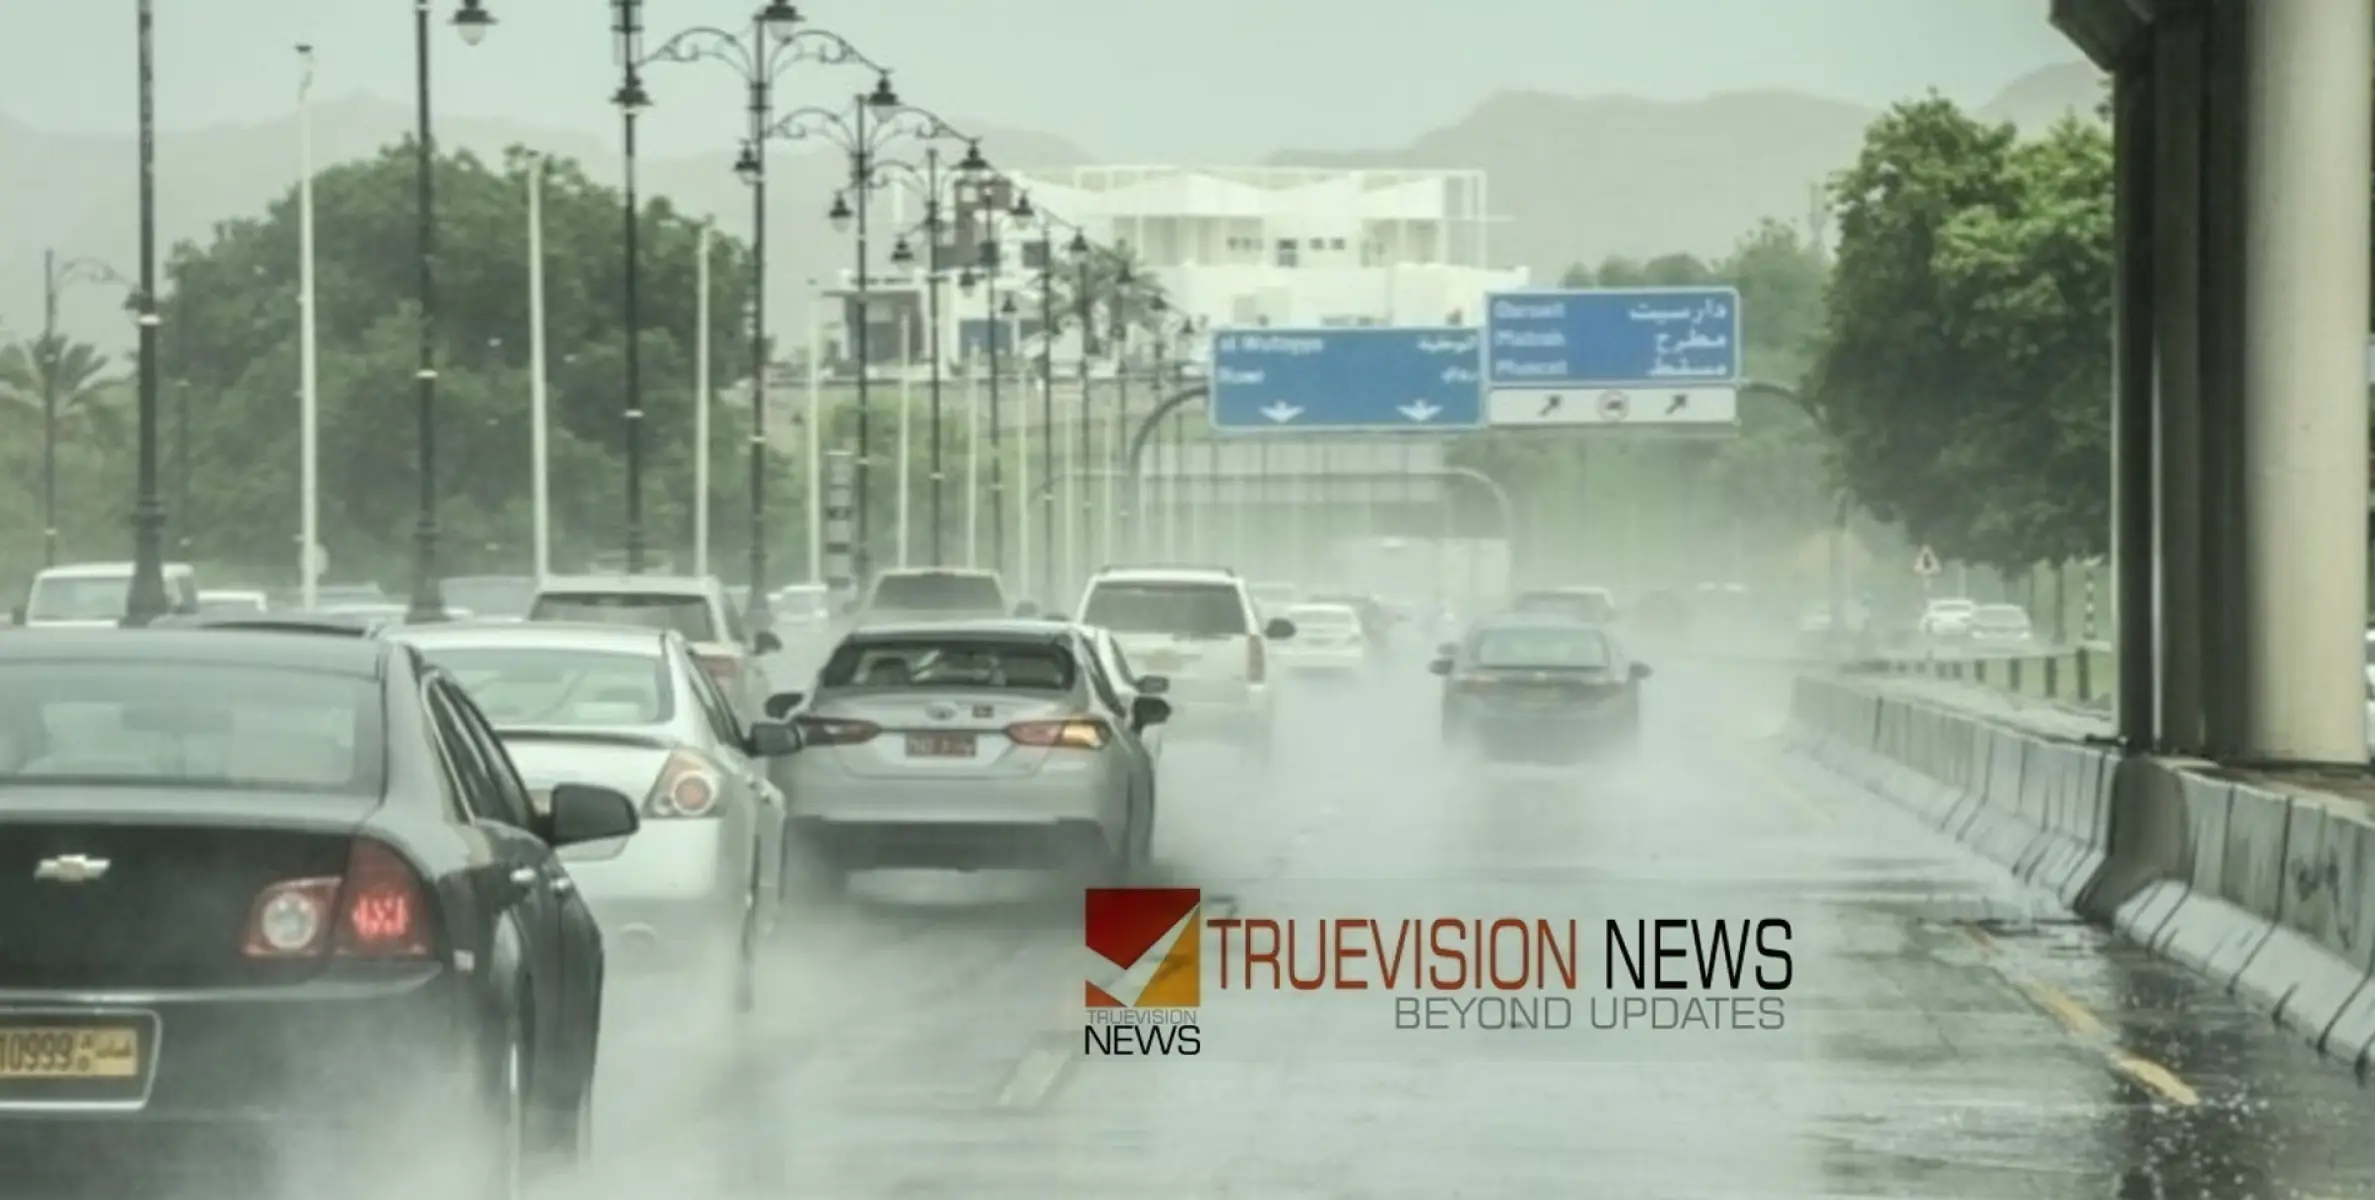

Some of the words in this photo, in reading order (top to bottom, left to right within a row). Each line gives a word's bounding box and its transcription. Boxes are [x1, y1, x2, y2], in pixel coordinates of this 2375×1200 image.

[1628, 298, 1727, 326] دارسيت
[1655, 329, 1726, 356] مطرح
[1646, 357, 1727, 377] مسقط
